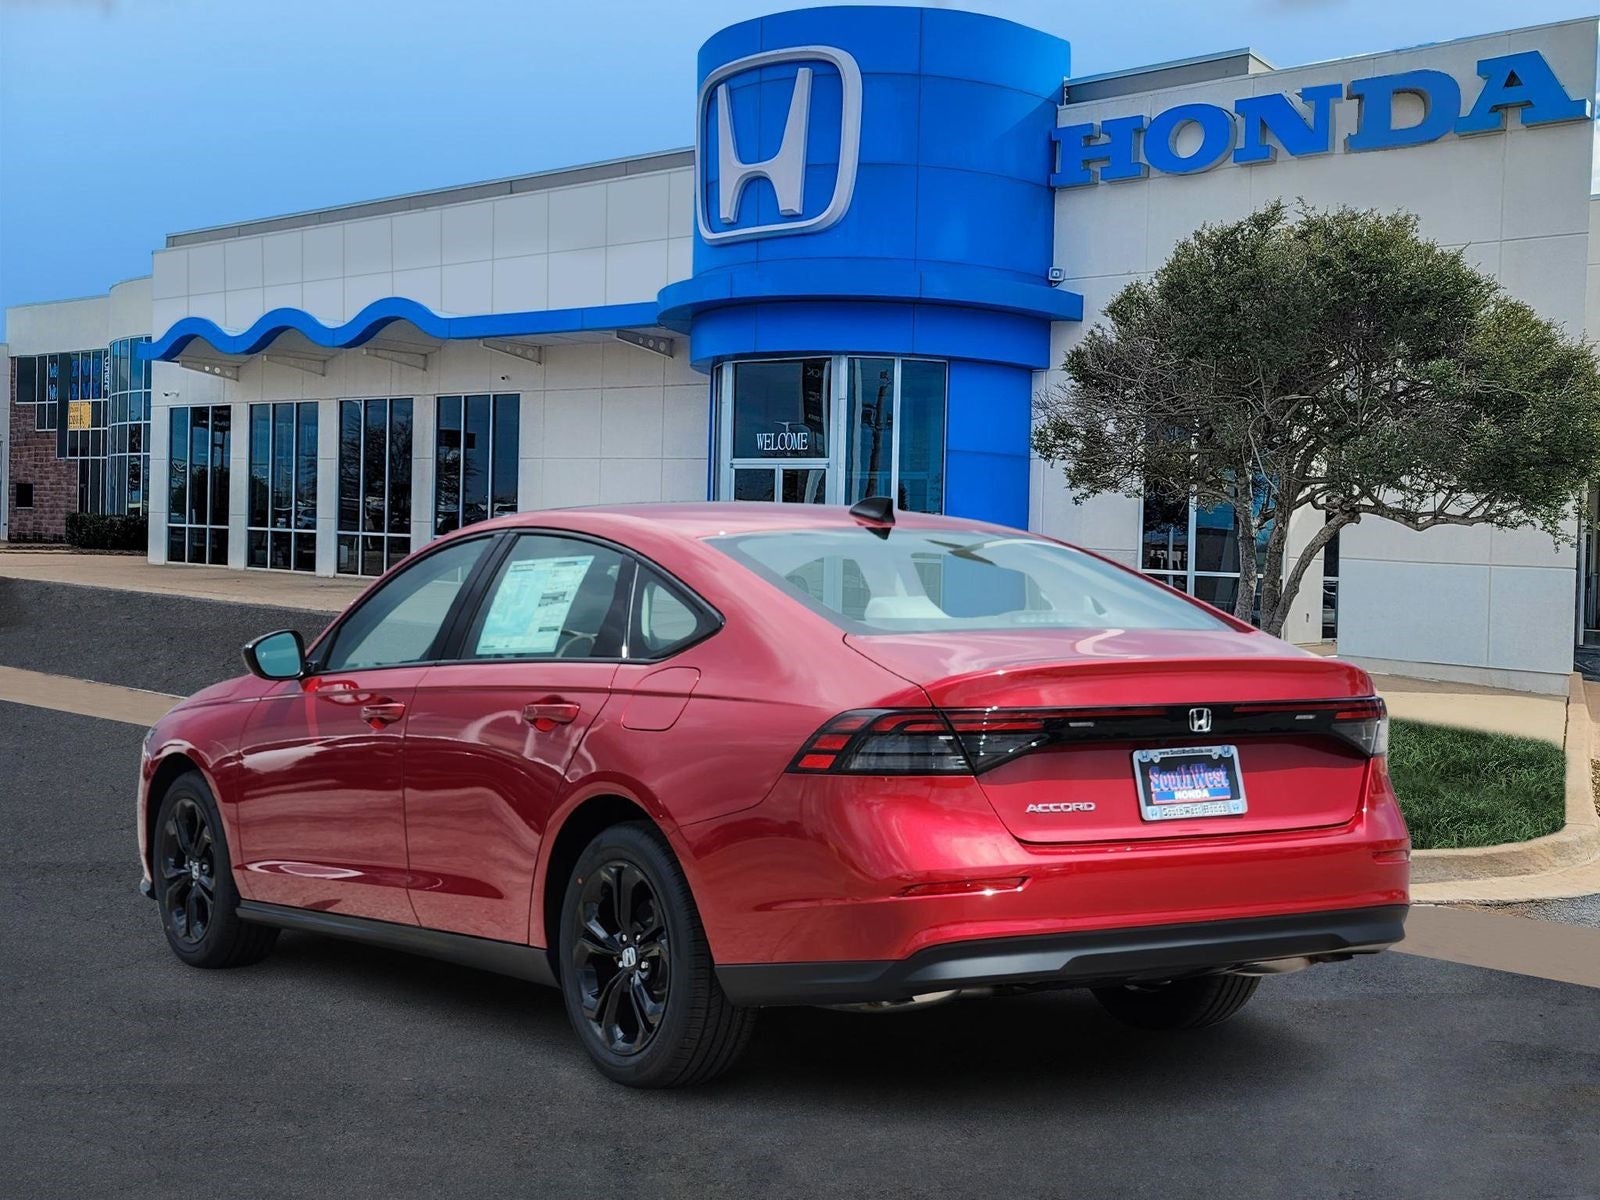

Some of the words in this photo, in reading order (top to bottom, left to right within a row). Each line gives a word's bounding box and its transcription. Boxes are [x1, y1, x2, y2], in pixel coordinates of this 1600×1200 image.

[1050, 50, 1592, 188] HONDA
[756, 432, 808, 450] WELCOME
[1174, 789, 1210, 800] HONDA
[1024, 802, 1096, 813] ACCORD
